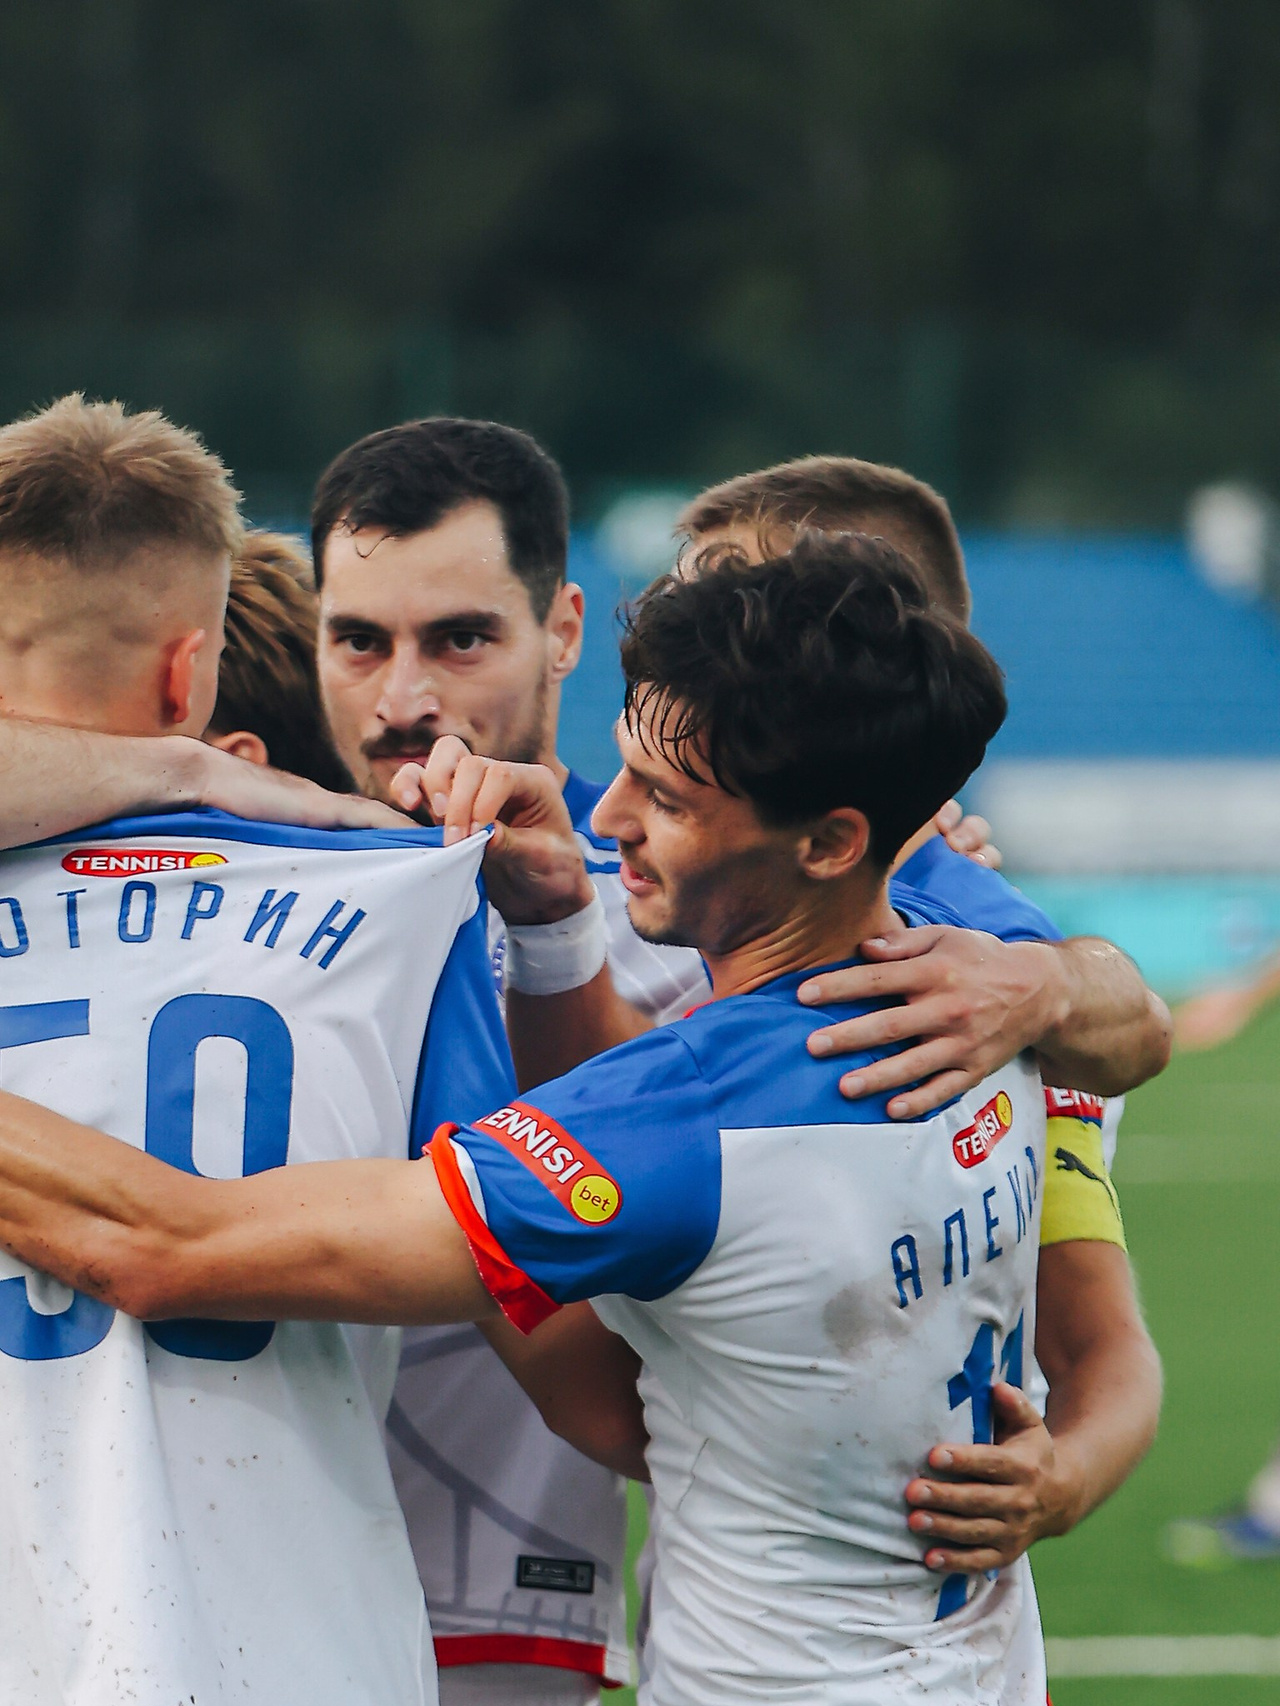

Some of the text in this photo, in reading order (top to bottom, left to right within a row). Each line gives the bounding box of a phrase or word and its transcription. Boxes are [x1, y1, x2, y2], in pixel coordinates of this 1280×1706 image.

[71, 857, 185, 871] TENNISI
[476, 1107, 611, 1212] ENNISI bet
[933, 1308, 1024, 1622] 1
